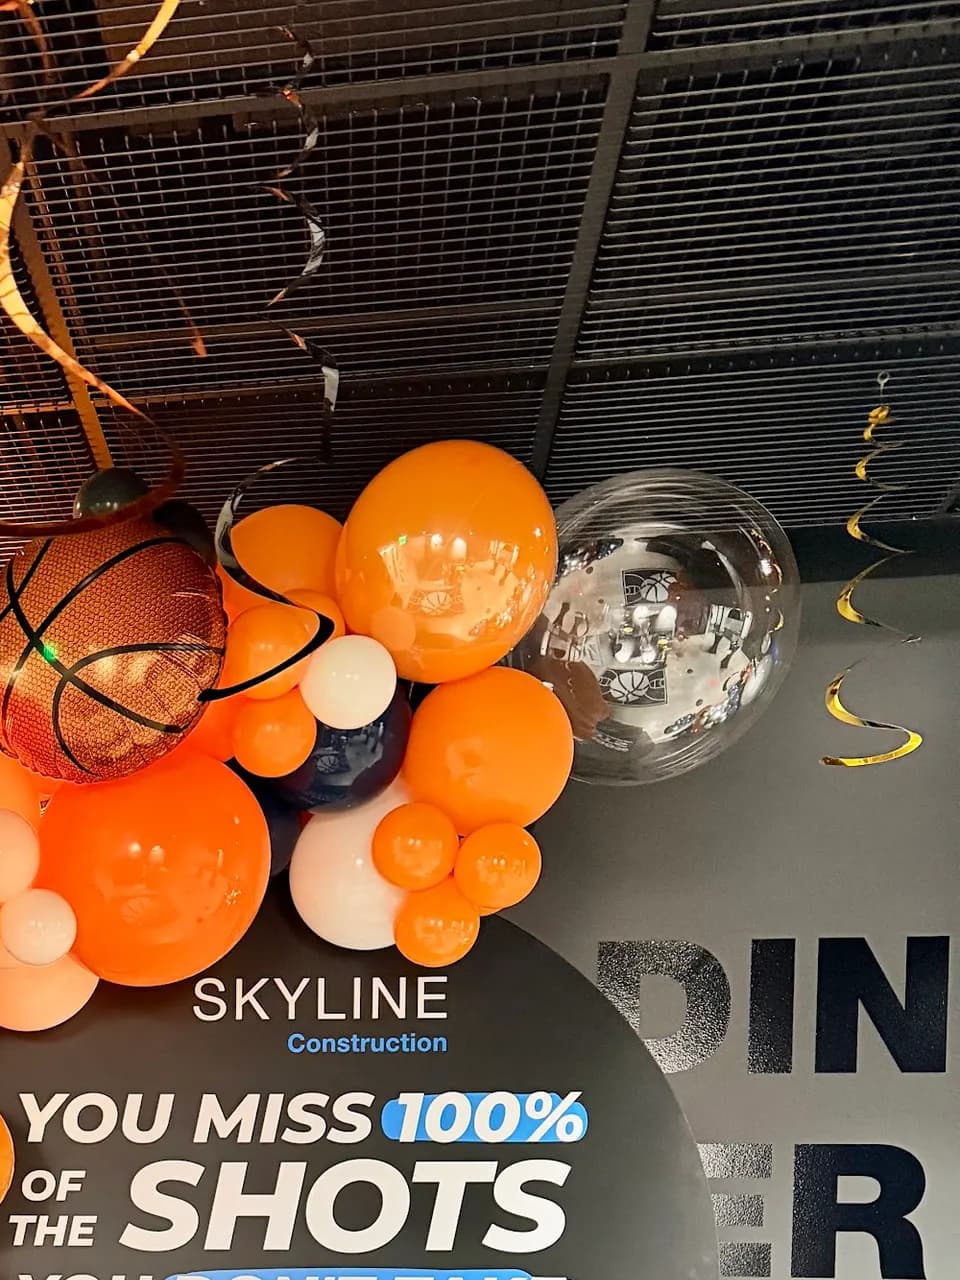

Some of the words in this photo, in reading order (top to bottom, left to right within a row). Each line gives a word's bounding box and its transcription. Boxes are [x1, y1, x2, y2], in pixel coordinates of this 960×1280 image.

[192, 976, 449, 1021] SKYLINE
[286, 1033, 449, 1055] Construction
[18, 1093, 175, 1144] YOU
[193, 1092, 373, 1144] MISS
[396, 1091, 583, 1145] 100%
[21, 1170, 87, 1202] OF
[118, 1158, 573, 1254] SHOTS
[8, 1214, 96, 1247] THE
